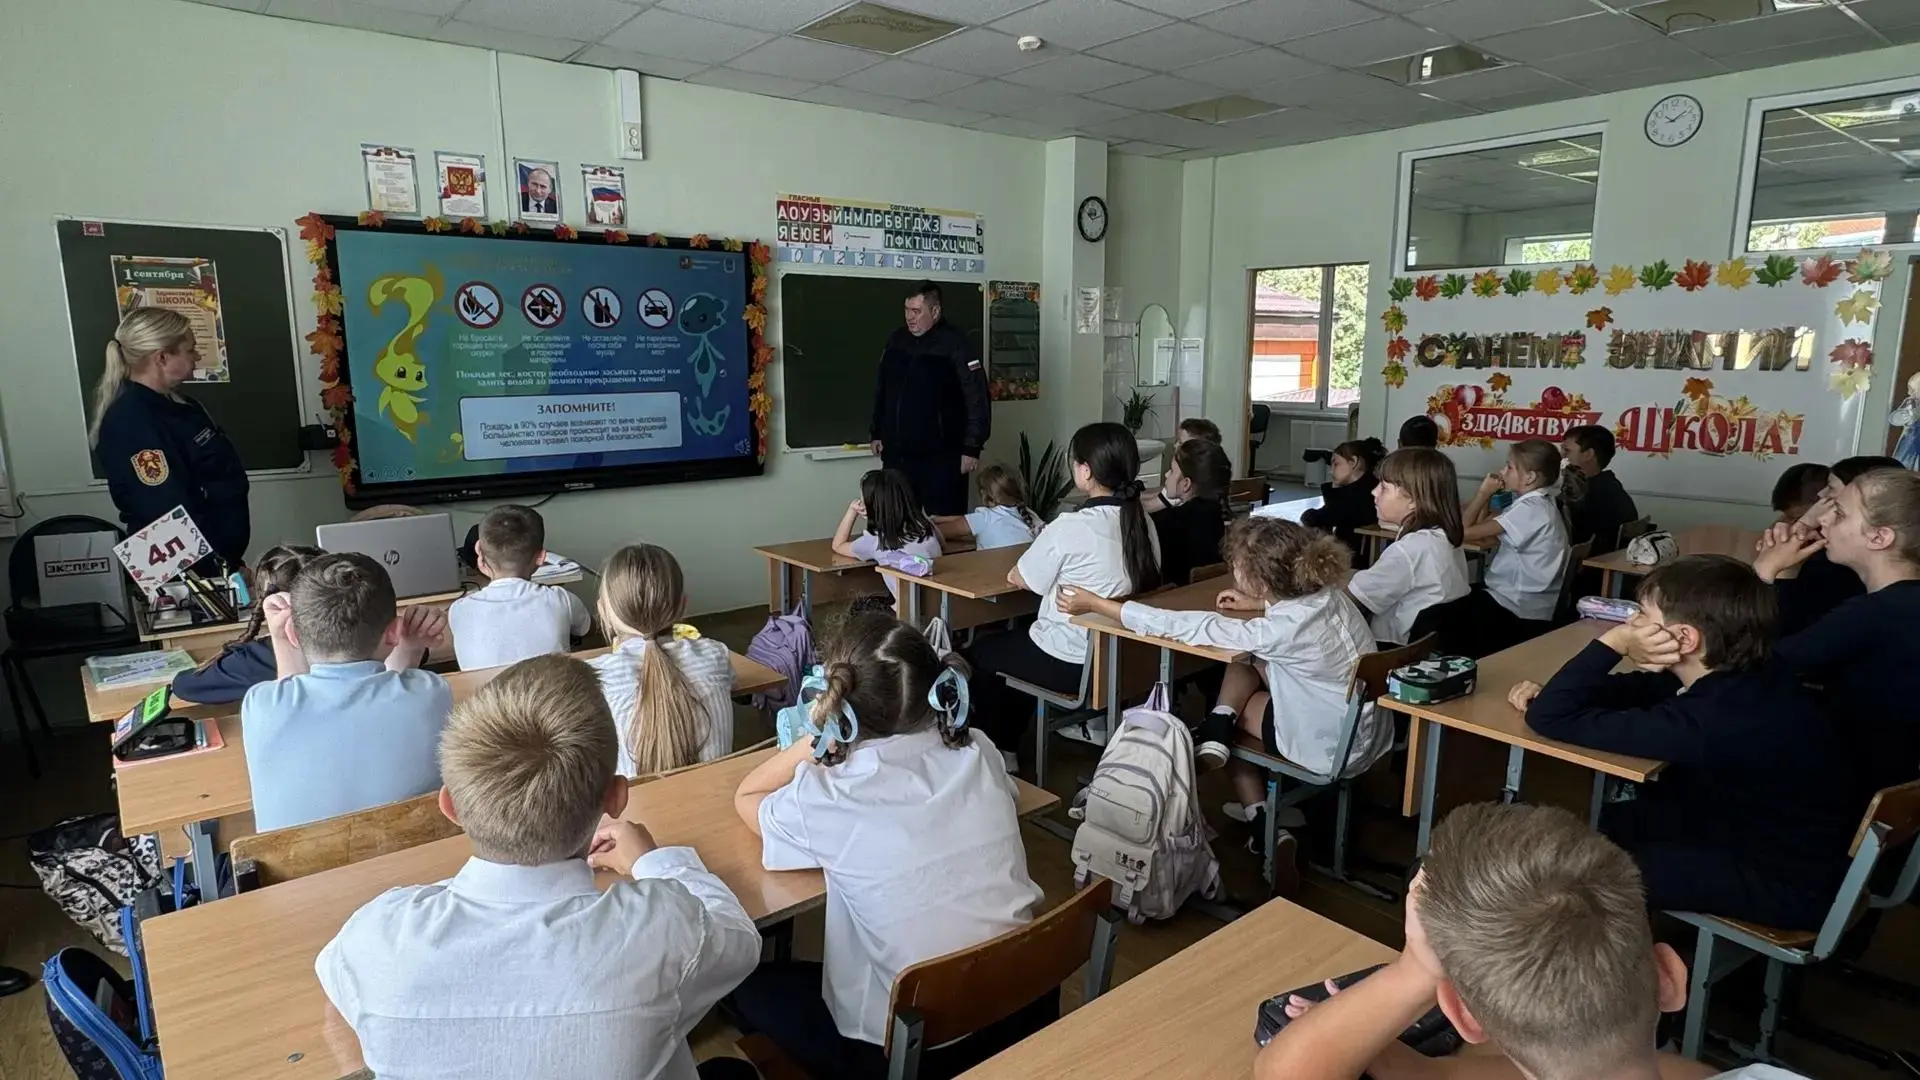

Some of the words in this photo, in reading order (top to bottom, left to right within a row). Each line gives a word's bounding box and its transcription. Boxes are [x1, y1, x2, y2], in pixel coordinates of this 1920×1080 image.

[124, 268, 133, 280] 1
[134, 270, 184, 280] сентября
[1418, 336, 1445, 368] С
[537, 402, 616, 414] ЗАПОМНИТЕ!
[1618, 406, 1804, 455] ШКОЛА!
[47, 561, 107, 574] ЭКСПЕРТ
